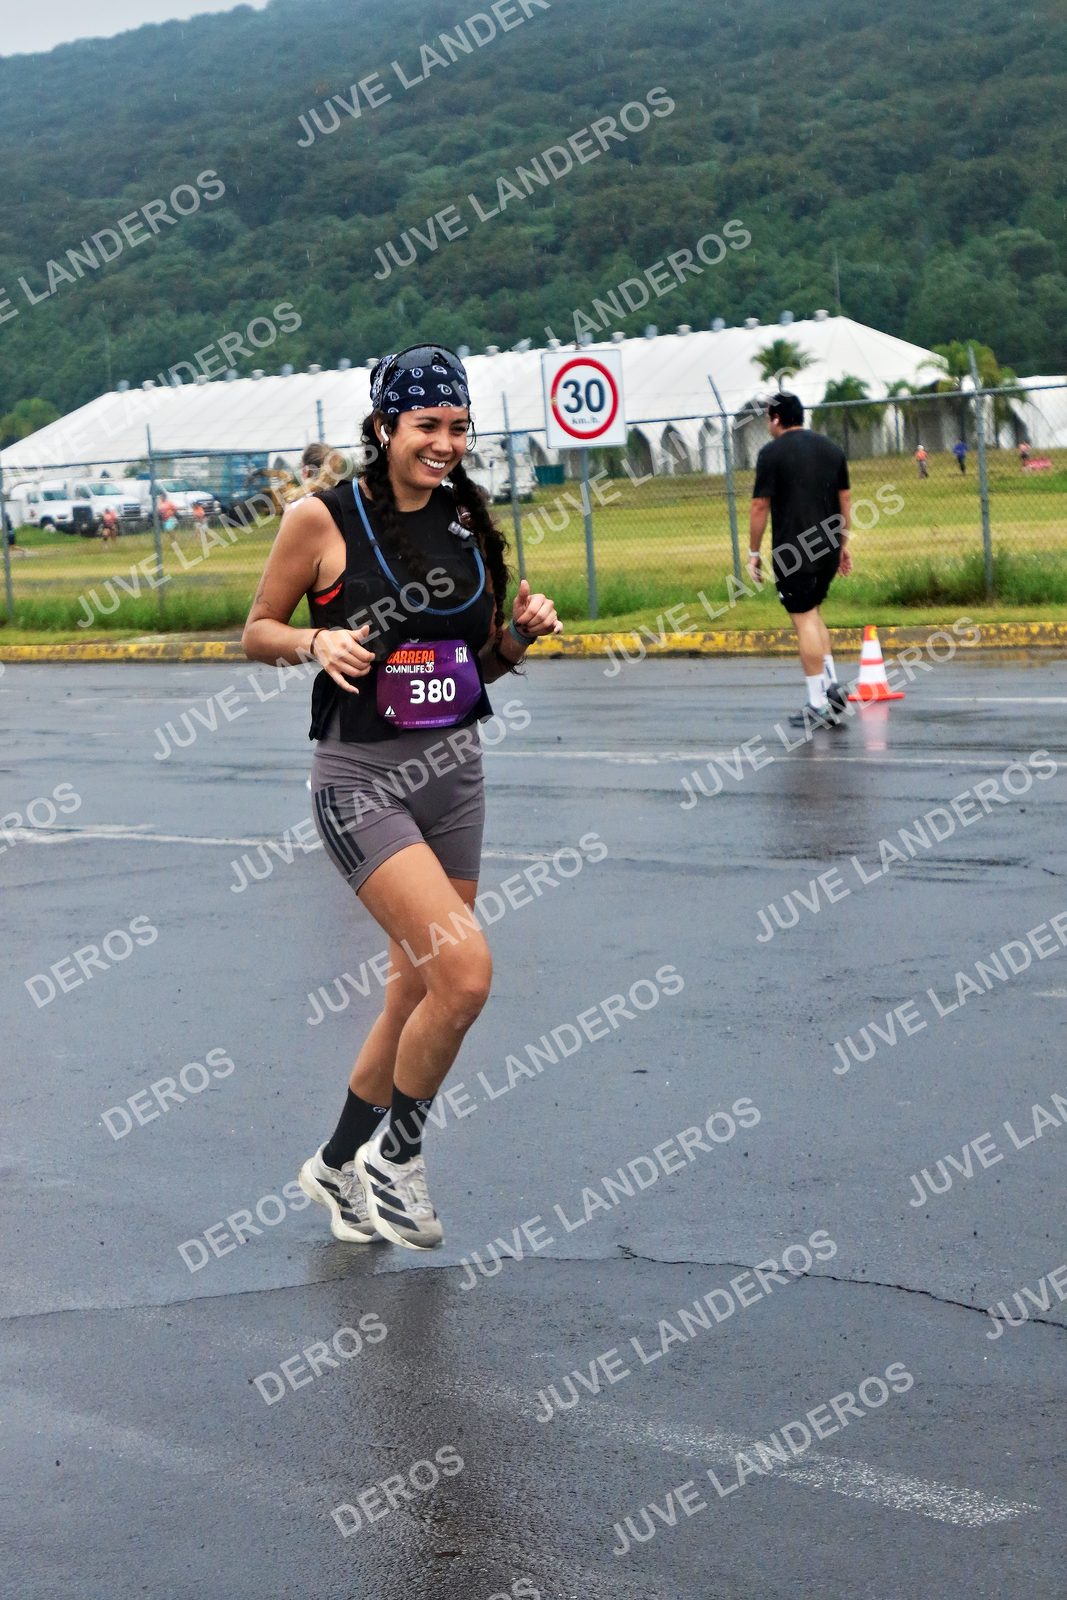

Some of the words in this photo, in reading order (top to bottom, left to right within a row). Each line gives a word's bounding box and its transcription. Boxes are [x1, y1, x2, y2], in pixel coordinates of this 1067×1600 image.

[562, 378, 605, 413] 30
[385, 664, 425, 673] OMNILIFE
[410, 677, 456, 704] 380
